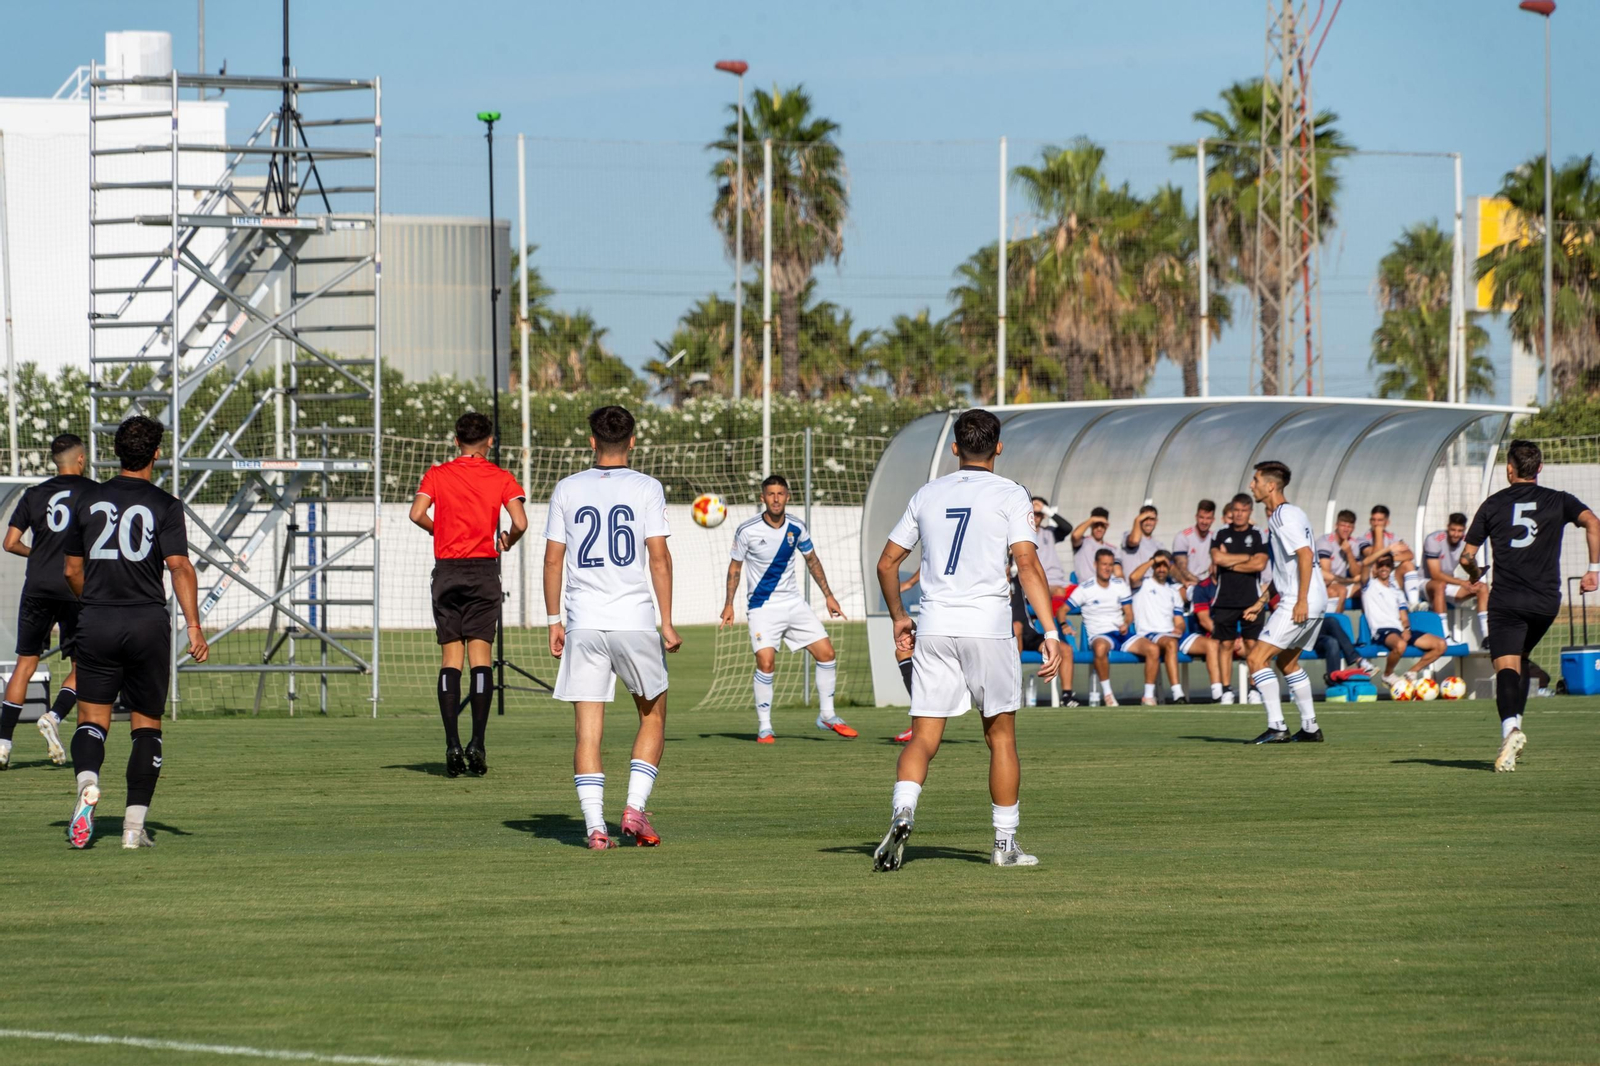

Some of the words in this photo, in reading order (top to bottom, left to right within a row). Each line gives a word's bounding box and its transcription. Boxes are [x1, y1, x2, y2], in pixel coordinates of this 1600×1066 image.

[46, 490, 71, 532] 6
[89, 501, 154, 562] 20
[574, 504, 636, 569] 26
[944, 507, 972, 576] 7
[1509, 502, 1539, 548] 5
